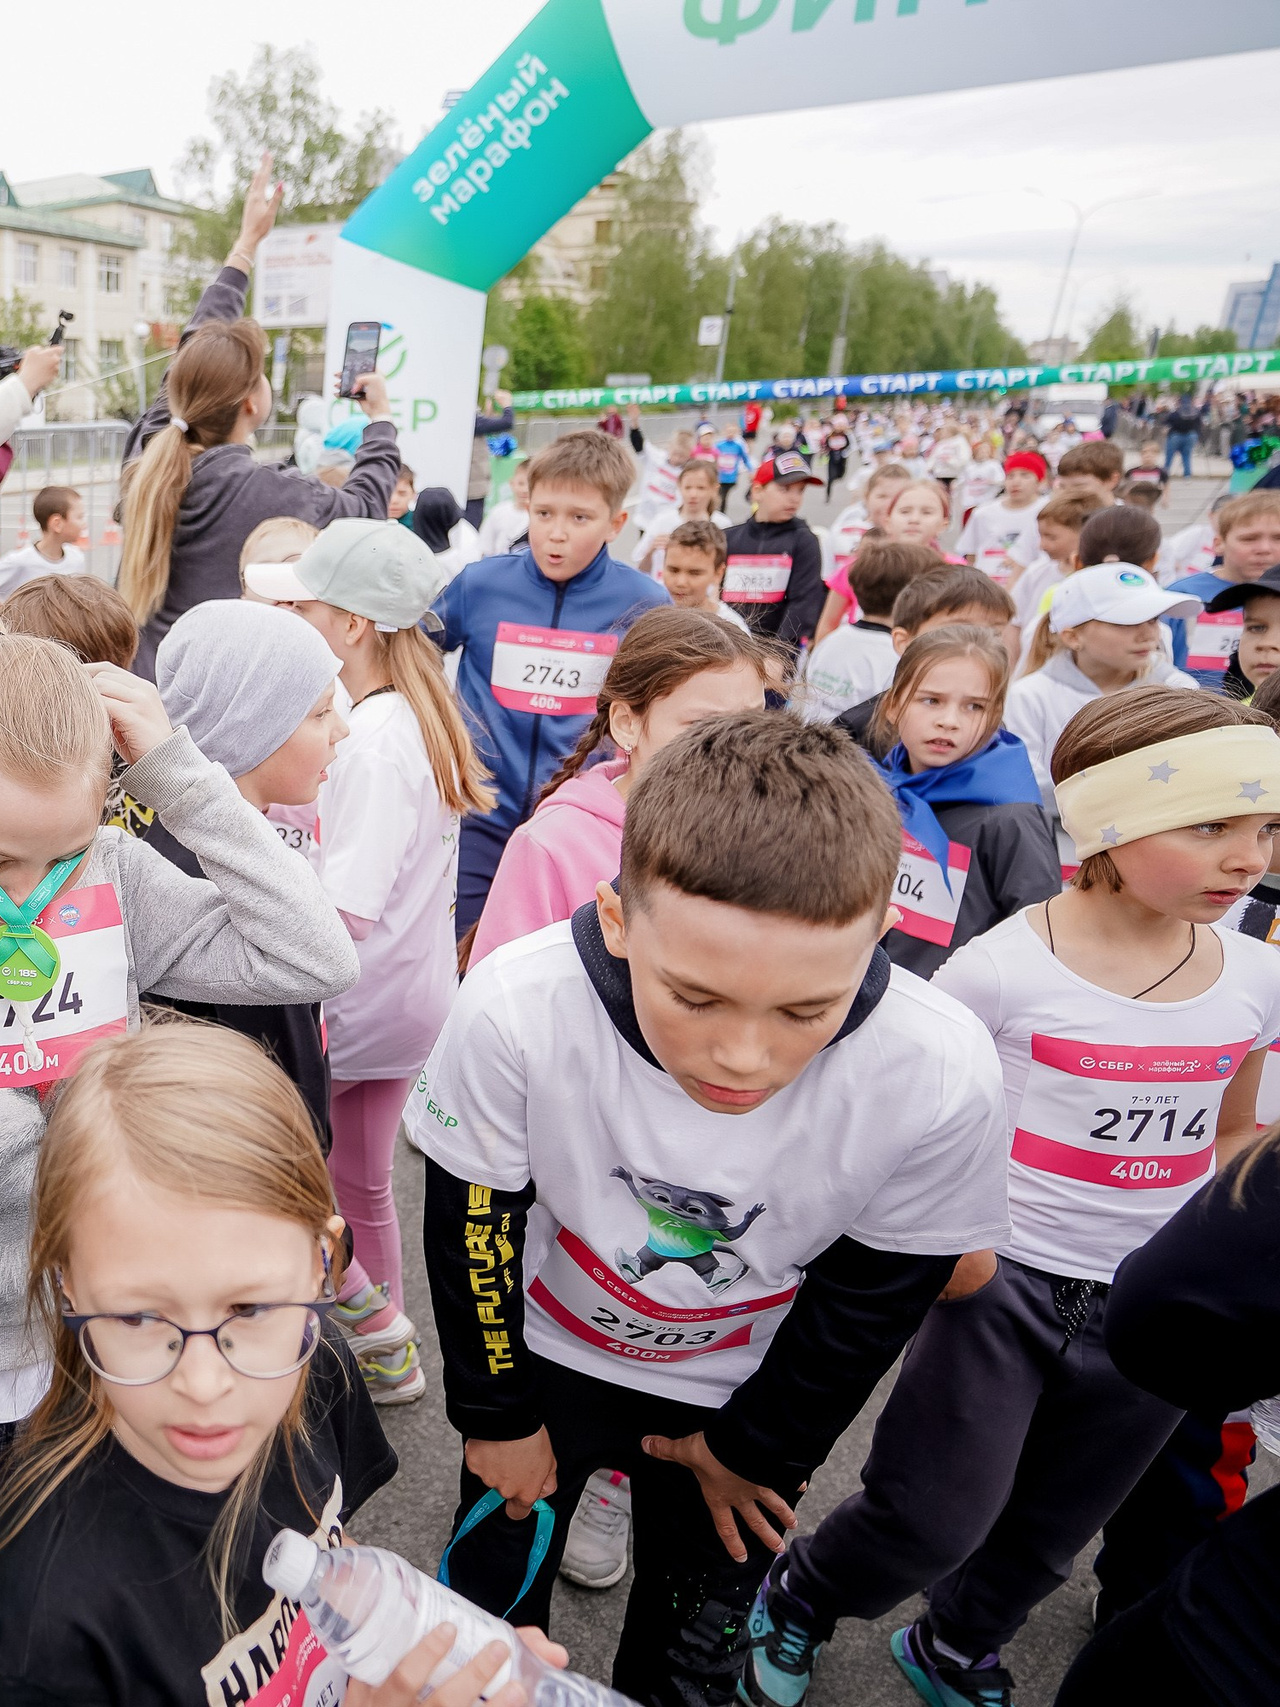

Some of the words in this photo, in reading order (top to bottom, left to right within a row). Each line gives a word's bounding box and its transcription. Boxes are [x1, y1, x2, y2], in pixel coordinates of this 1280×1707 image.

[412, 52, 548, 203] зелёный
[429, 77, 570, 226] марафон
[542, 389, 605, 408] СТАРТ
[613, 384, 681, 404] СТАРТ
[690, 381, 762, 402] СТАРТ
[771, 377, 850, 397] СТАРТ
[860, 371, 942, 395] СТАРТ
[954, 366, 1043, 390] СТАРТ
[1058, 360, 1154, 384] СТАРТ
[1171, 352, 1276, 380] СТАРТ
[522, 664, 581, 689] 2743
[897, 872, 925, 902] 04
[18, 969, 38, 978] 185
[1098, 1060, 1134, 1071] СБЕР
[1152, 1059, 1185, 1067] зелёный
[1131, 1095, 1151, 1104] 7-9
[1154, 1095, 1180, 1104] ЛЕТ
[1089, 1108, 1208, 1143] 2714
[467, 1183, 493, 1216] IS
[501, 1212, 511, 1233] ON
[464, 1221, 505, 1324] FUTURE
[606, 1280, 637, 1304] СБЕР
[590, 1306, 717, 1346] 2703
[631, 1317, 652, 1328] 7-9
[482, 1329, 514, 1375] THE
